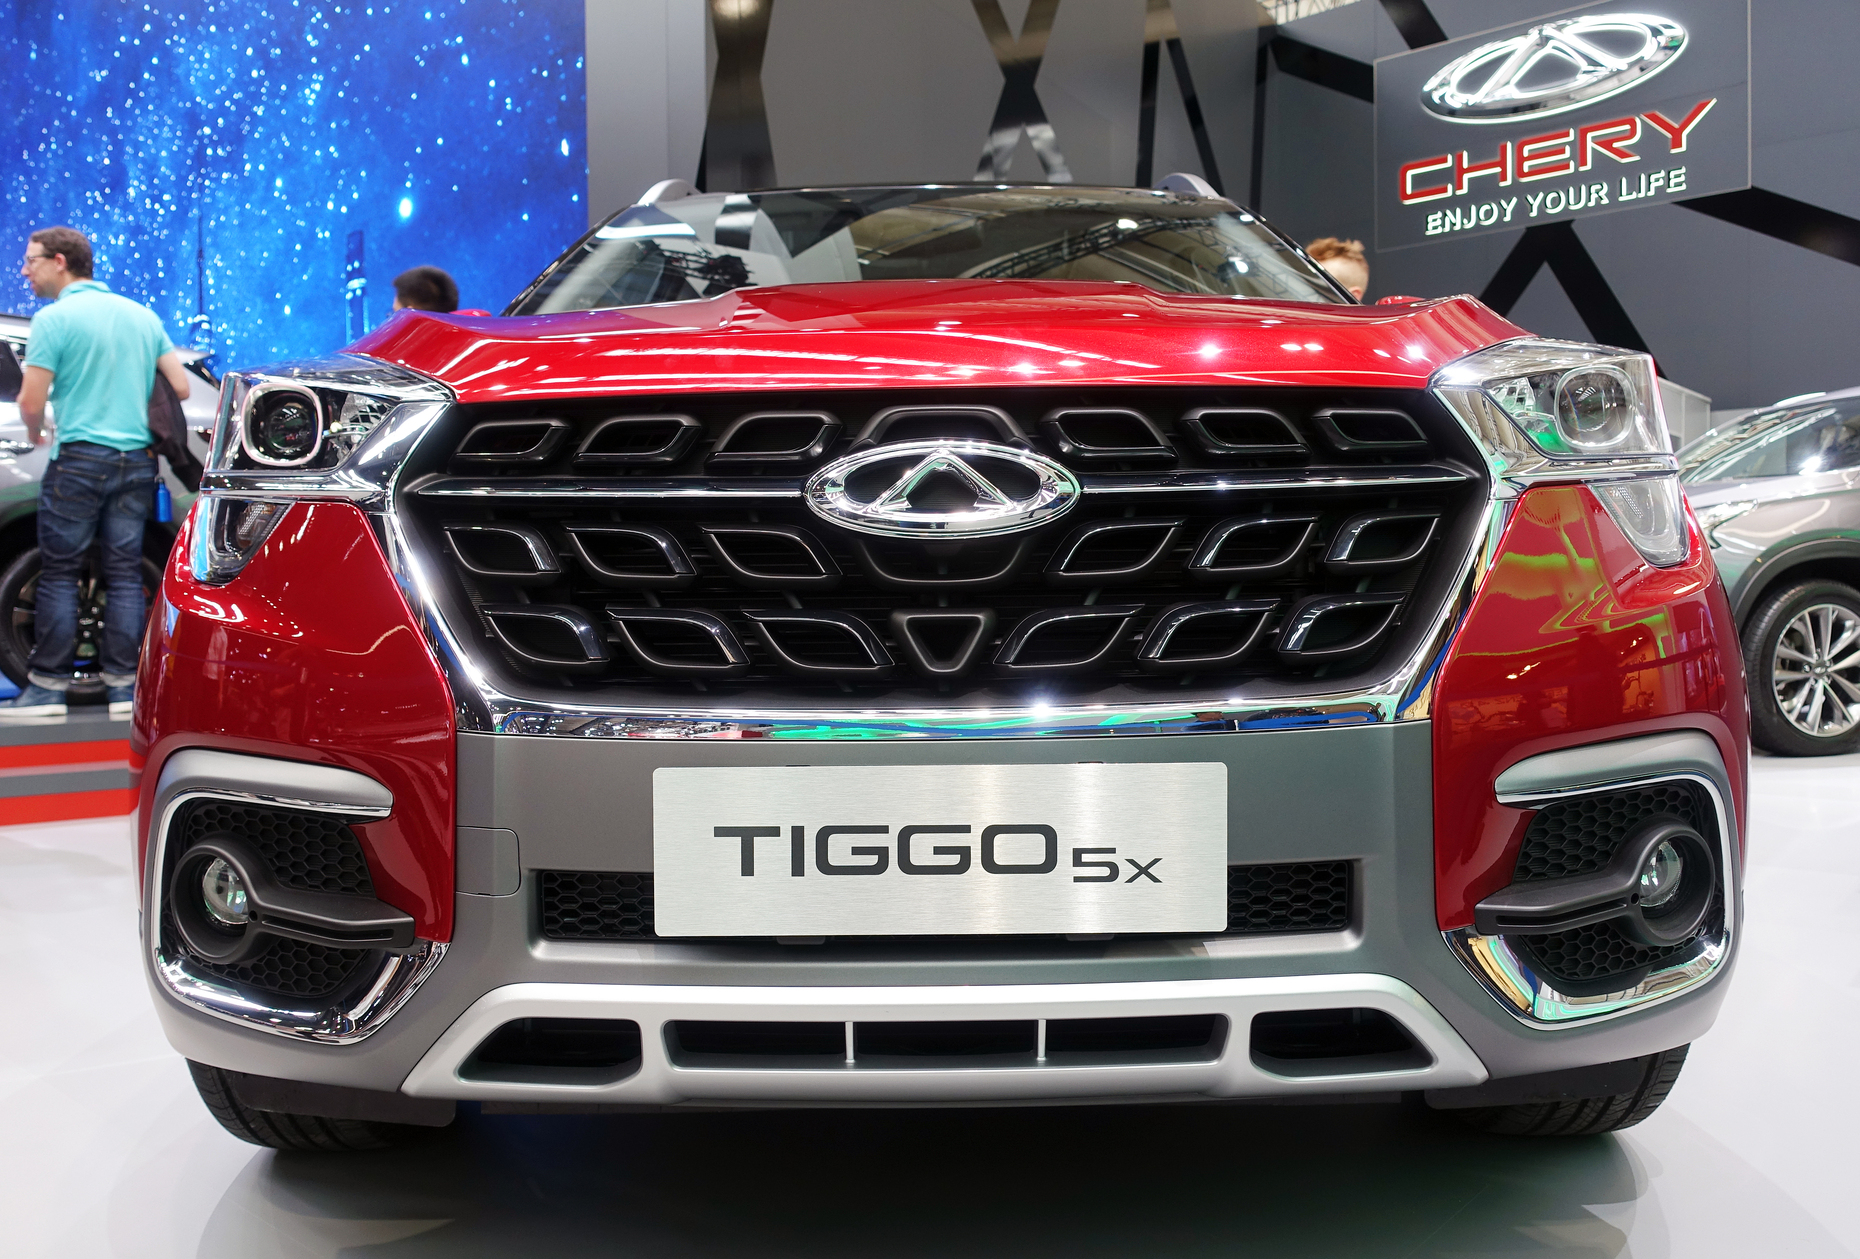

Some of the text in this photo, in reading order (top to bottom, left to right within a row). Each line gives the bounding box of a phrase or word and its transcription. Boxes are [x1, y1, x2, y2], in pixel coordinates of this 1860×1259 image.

[1400, 97, 1717, 204] CHERY
[1425, 166, 1688, 235] ENJOY YOUR LIFE
[713, 824, 1058, 877] TIGGO
